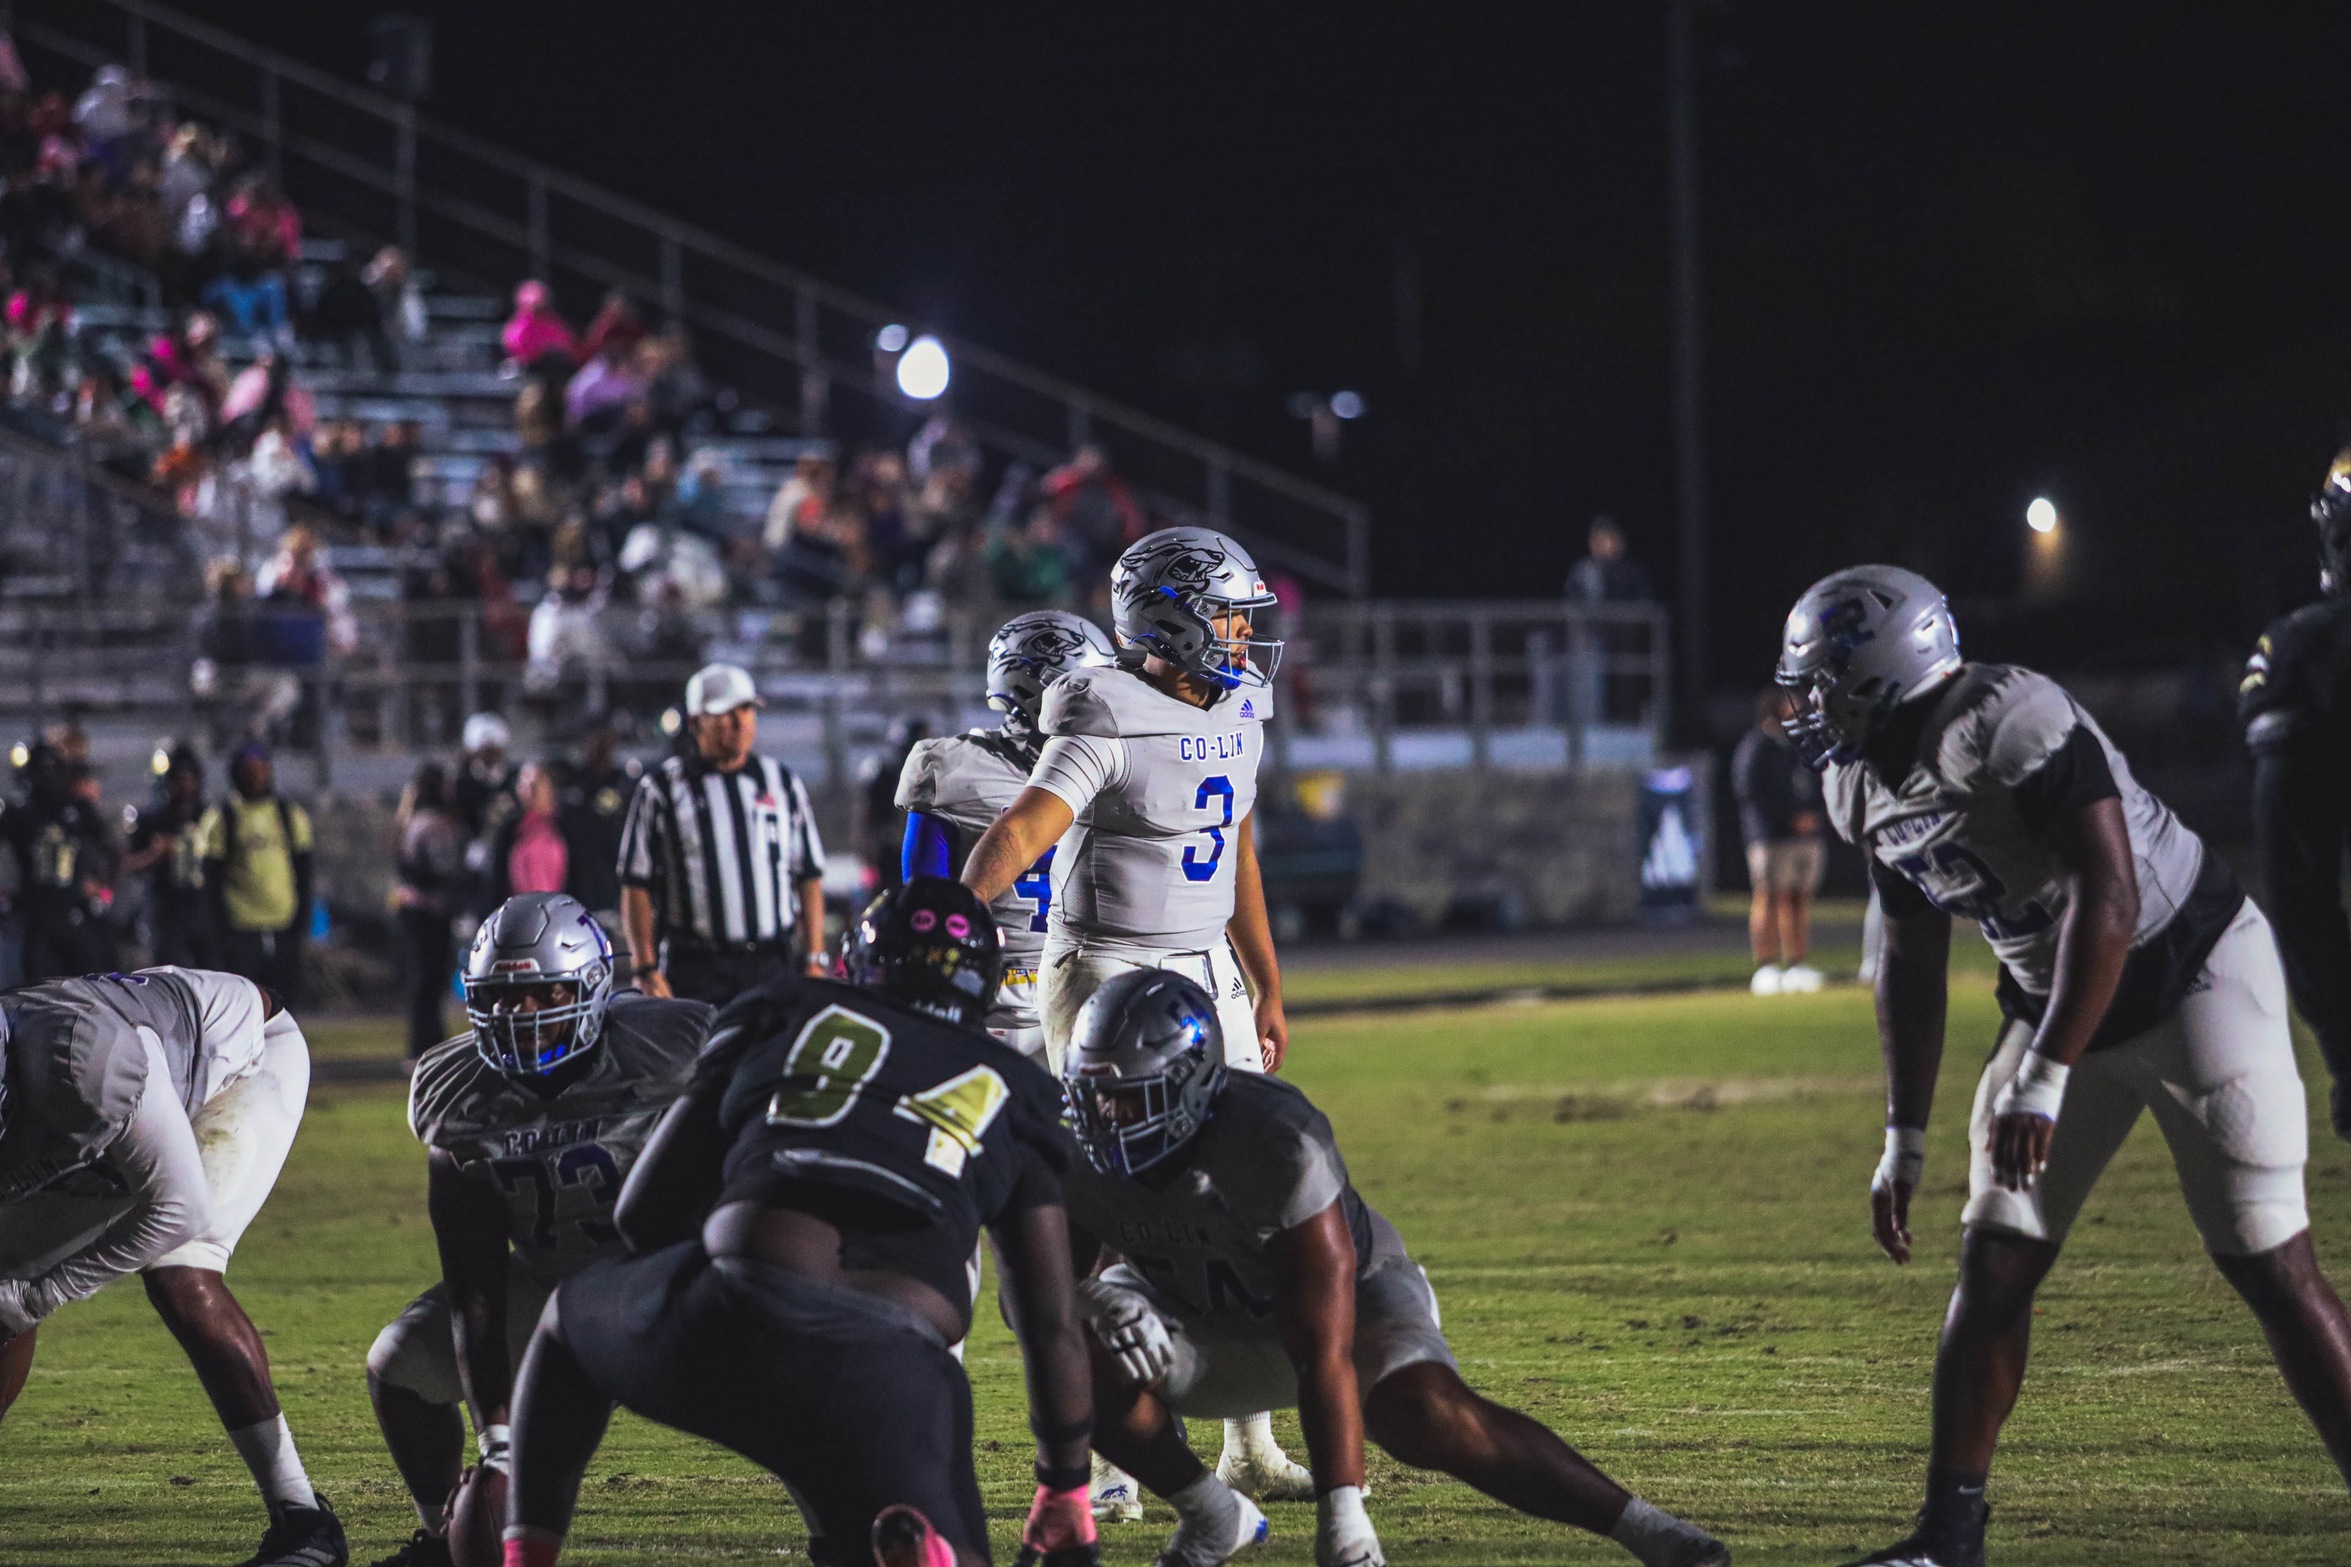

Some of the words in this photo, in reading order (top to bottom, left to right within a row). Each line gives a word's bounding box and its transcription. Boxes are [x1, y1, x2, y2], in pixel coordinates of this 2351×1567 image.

[1179, 731, 1245, 762] CO-LIN
[1180, 773, 1235, 883] 3
[766, 1002, 1011, 1180] 94
